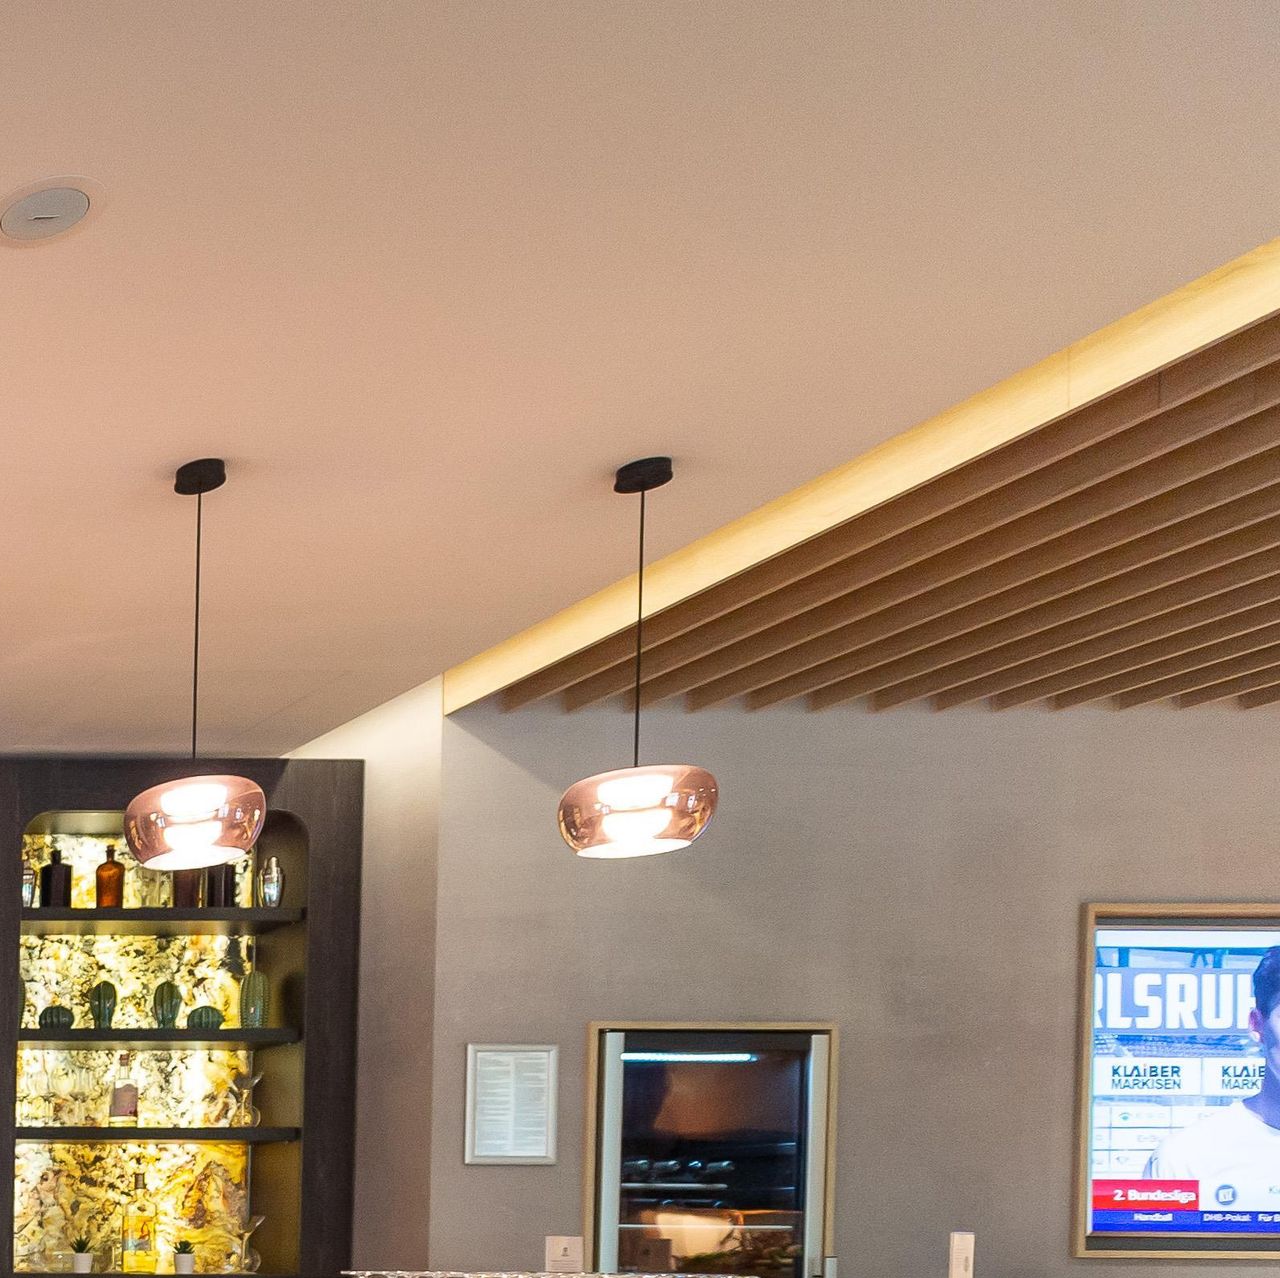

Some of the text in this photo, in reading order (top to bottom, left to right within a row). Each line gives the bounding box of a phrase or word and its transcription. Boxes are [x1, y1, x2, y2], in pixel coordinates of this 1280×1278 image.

[1111, 1078, 1181, 1090] MARKISEN
[1221, 1078, 1260, 1090] MARK
[1127, 1189, 1196, 1204] Bundesliga
